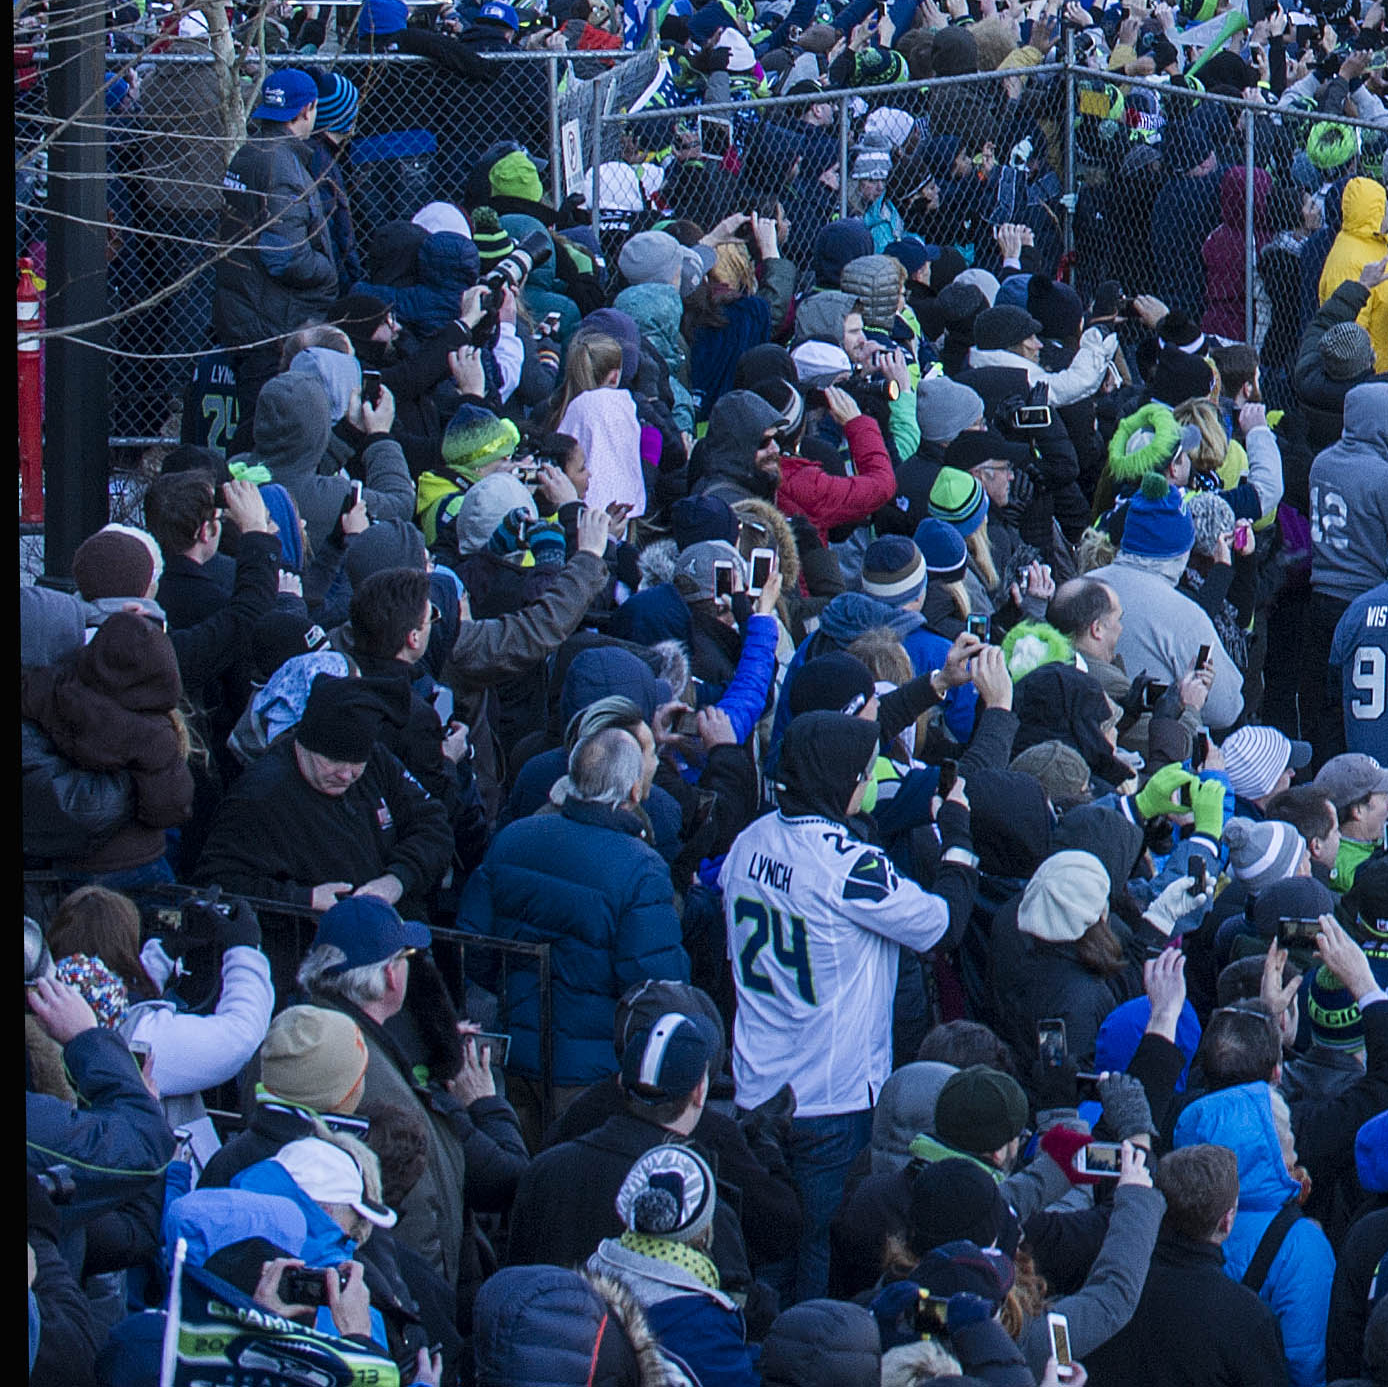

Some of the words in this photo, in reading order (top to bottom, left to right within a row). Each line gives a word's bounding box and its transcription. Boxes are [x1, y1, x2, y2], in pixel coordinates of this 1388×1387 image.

[1309, 485, 1349, 549] 12
[748, 852, 794, 894] LYNCH
[733, 896, 818, 1006] 24
